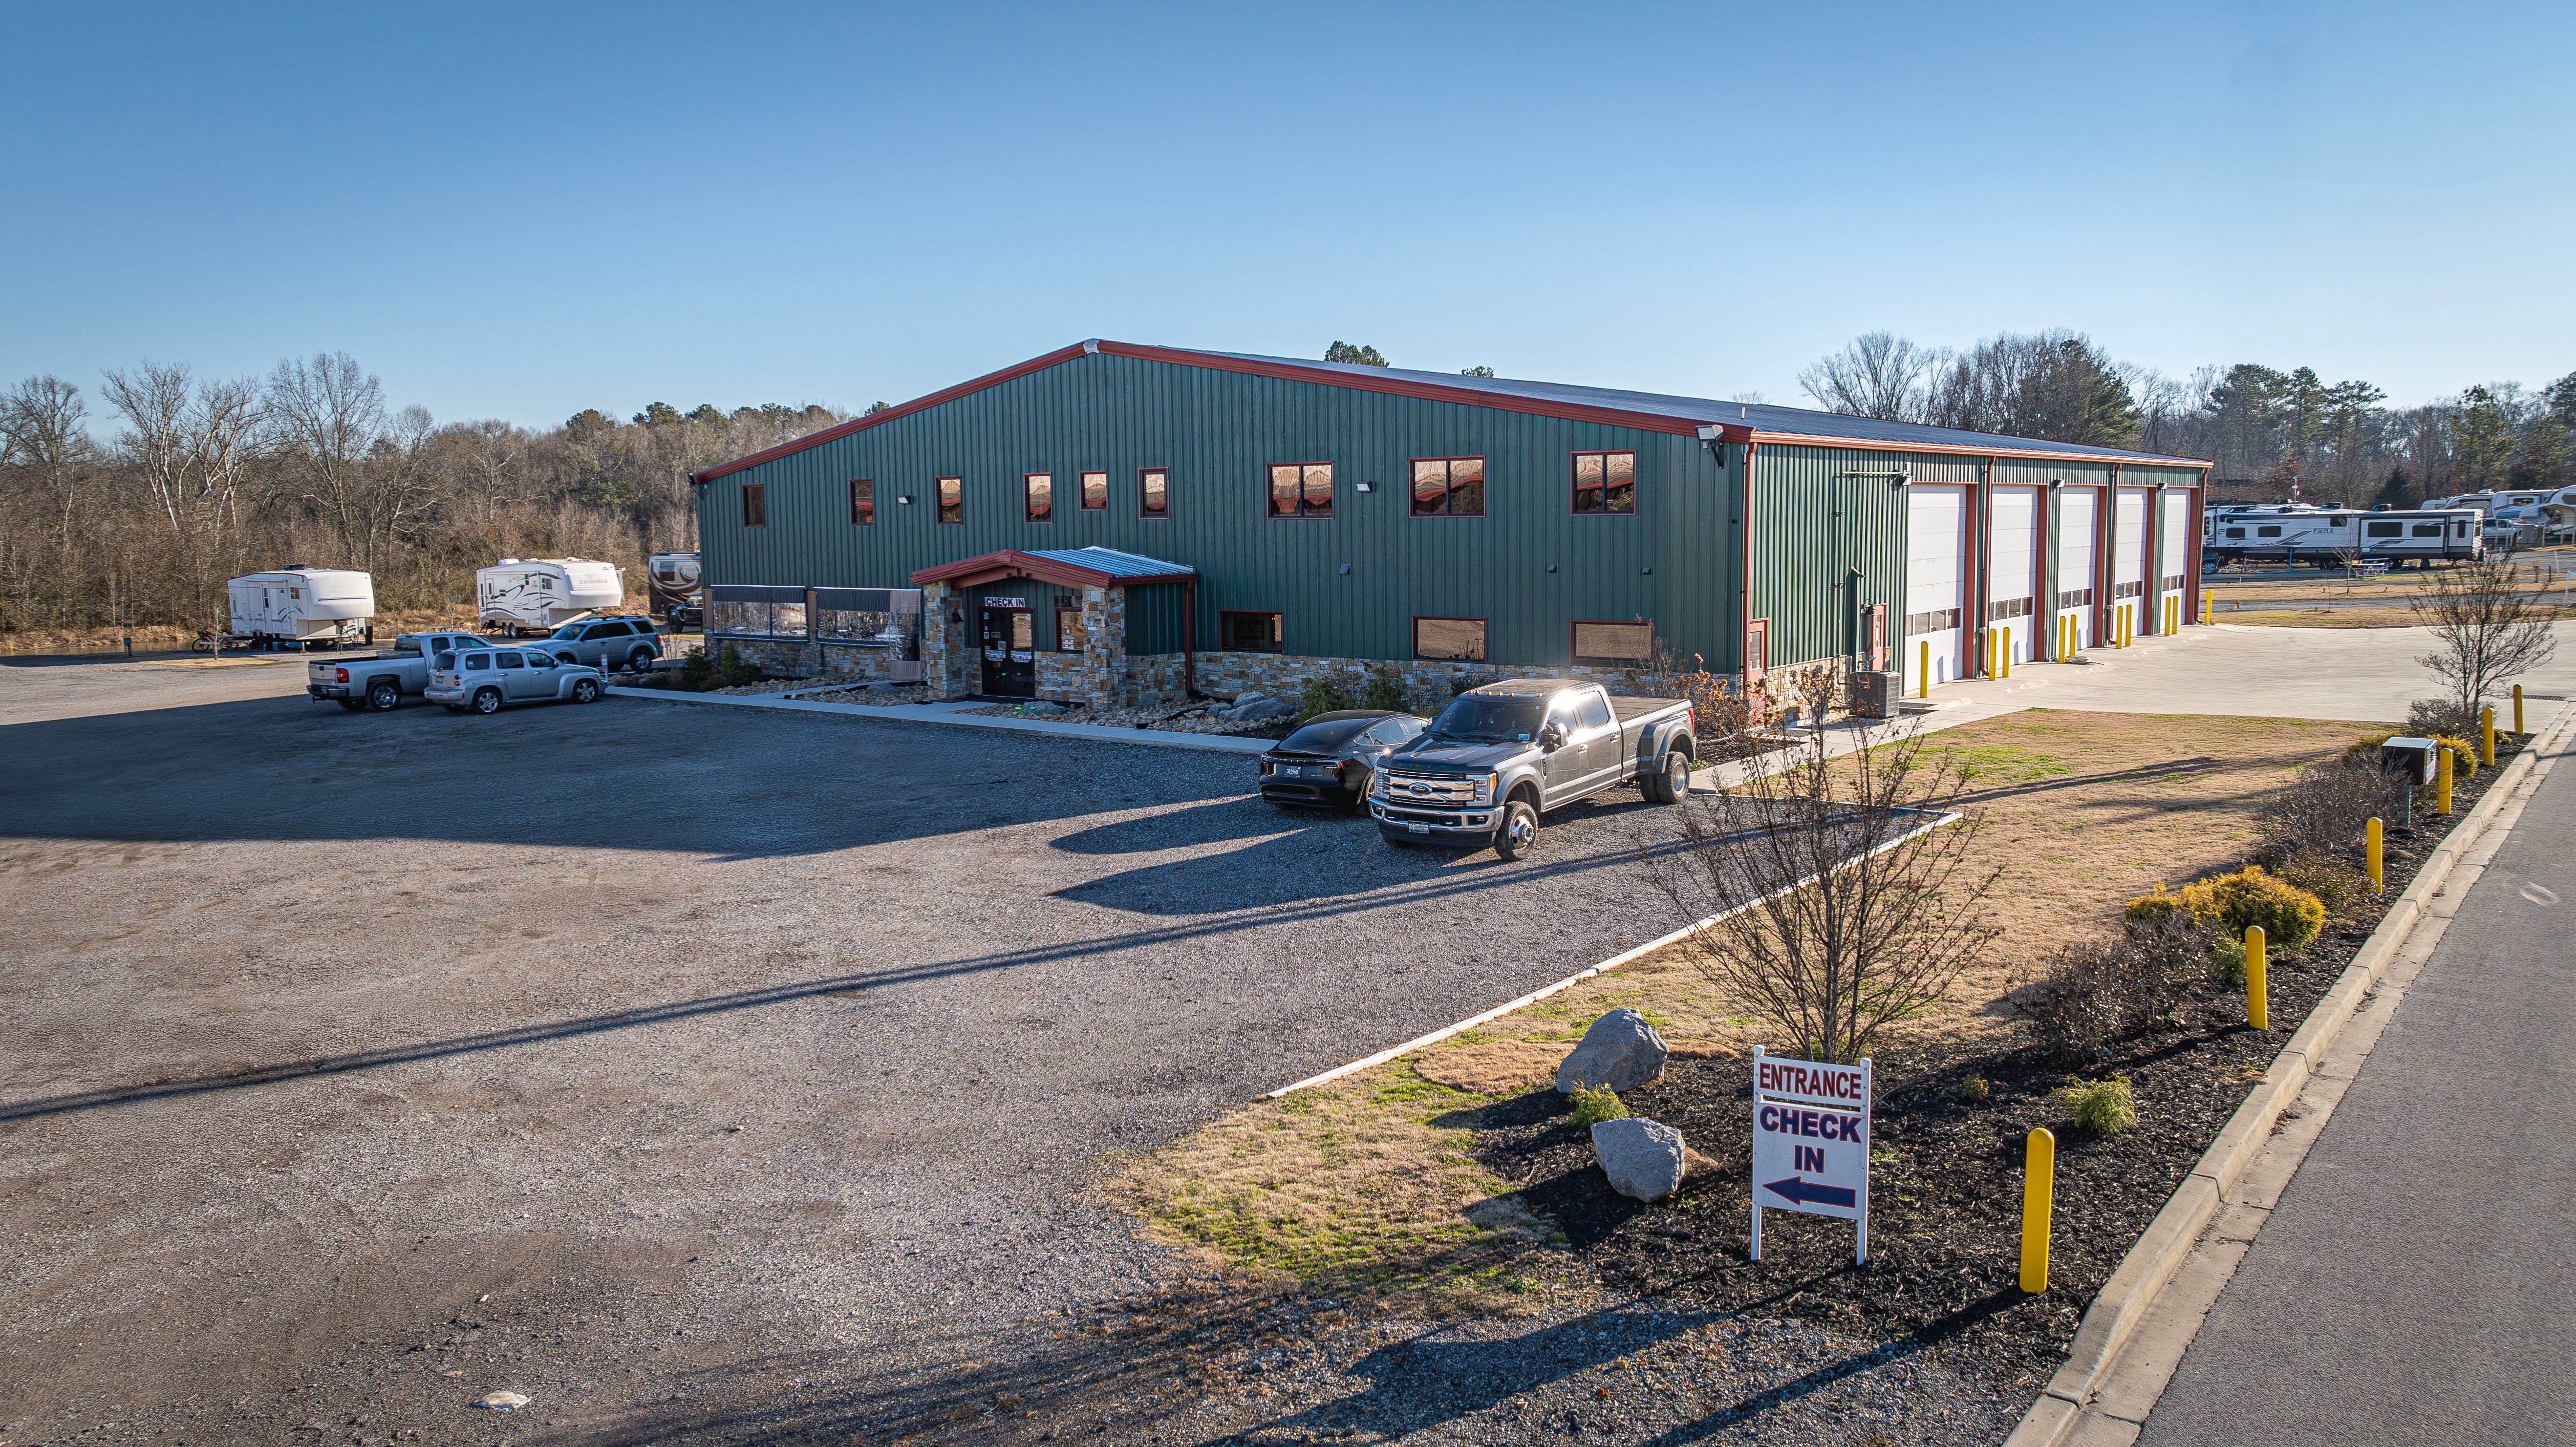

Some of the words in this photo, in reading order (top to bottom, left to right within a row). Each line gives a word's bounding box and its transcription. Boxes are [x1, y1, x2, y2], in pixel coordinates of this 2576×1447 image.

[986, 597, 1014, 607] CHECK
[1015, 598, 1024, 607] IN
[1759, 1062, 1862, 1100] ENTRANCE
[1760, 1106, 1862, 1144] CHECK
[1794, 1145, 1825, 1173] IN
